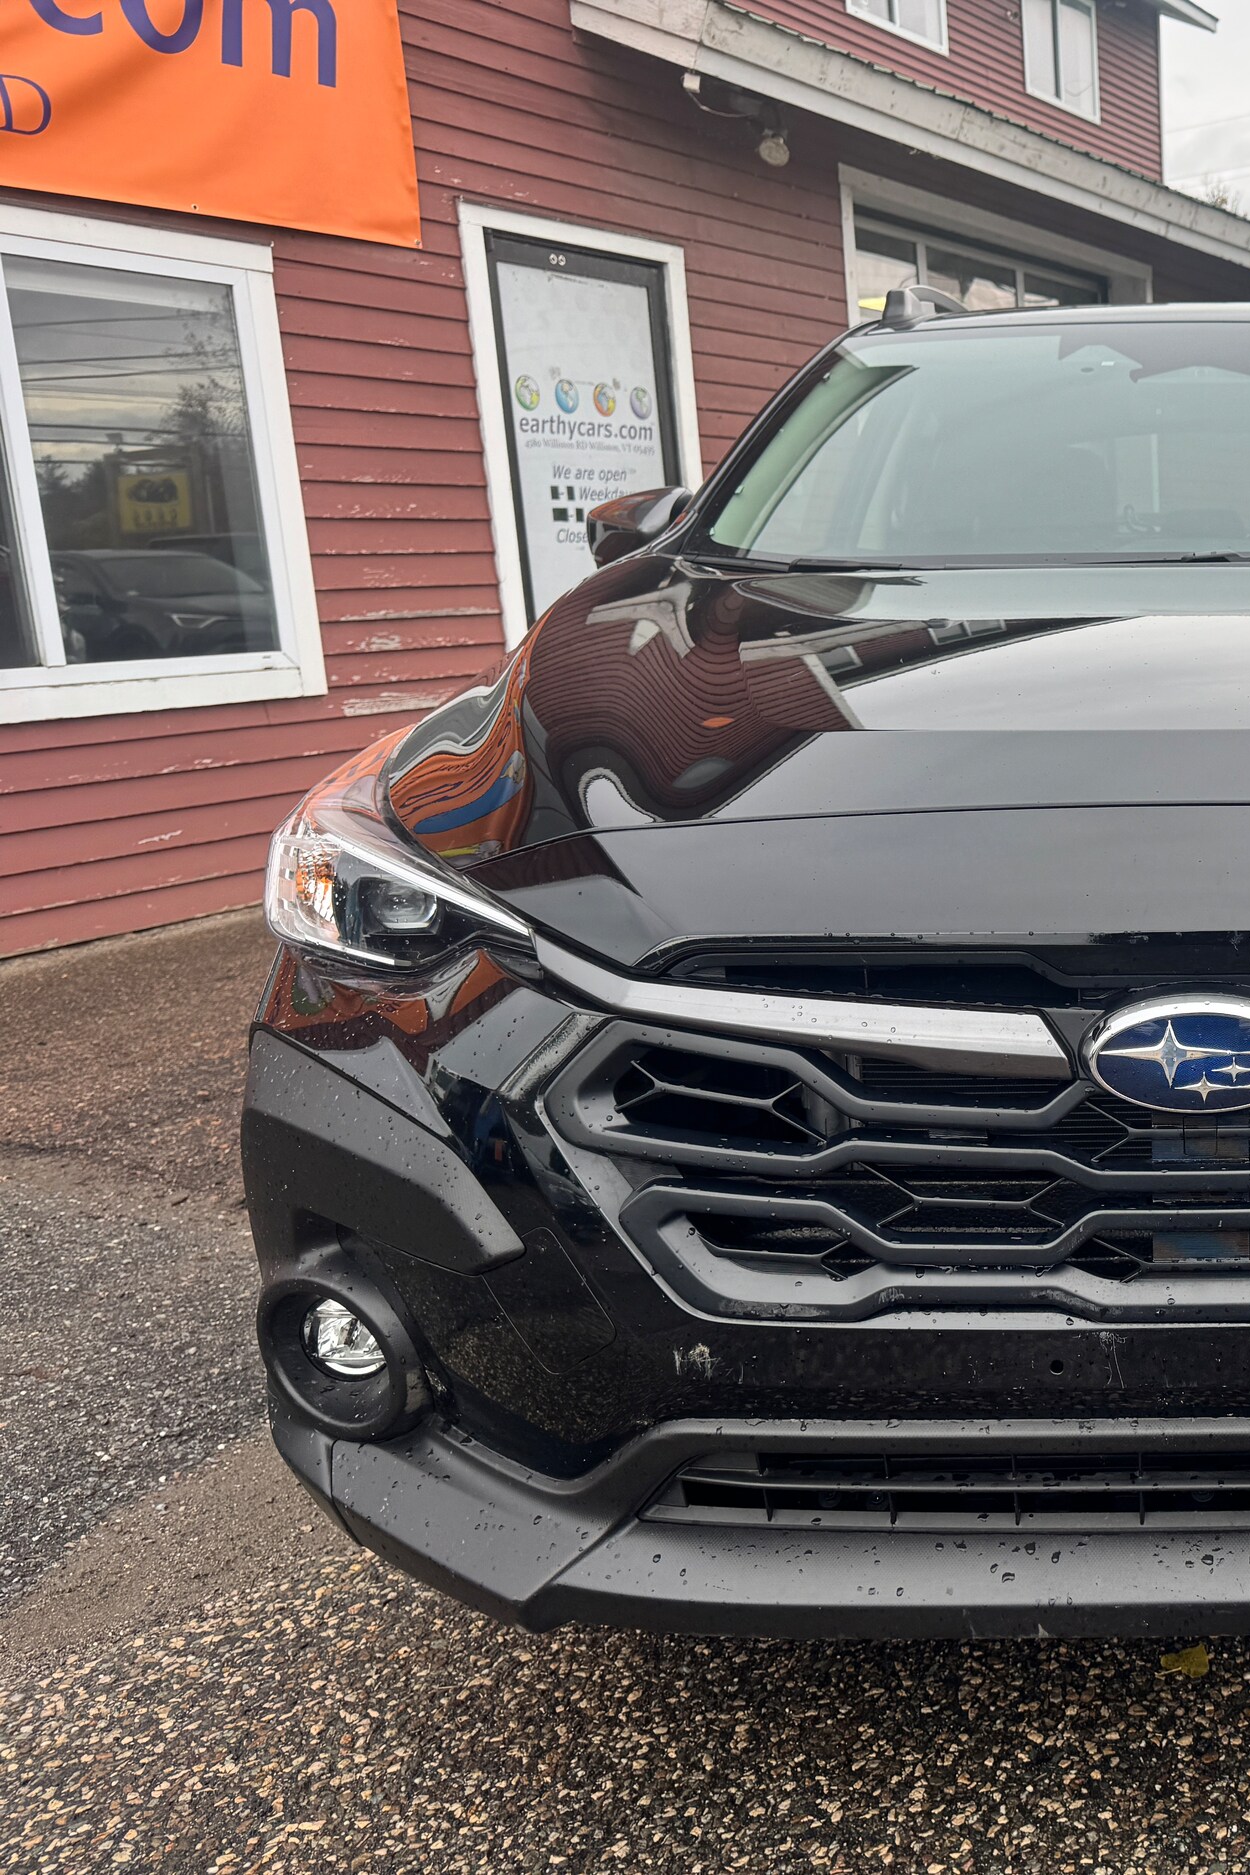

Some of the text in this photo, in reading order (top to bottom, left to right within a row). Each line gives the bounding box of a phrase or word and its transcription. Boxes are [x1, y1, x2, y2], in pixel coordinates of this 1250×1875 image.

[519, 415, 653, 441] earthycars.com
[553, 464, 627, 483] We are open
